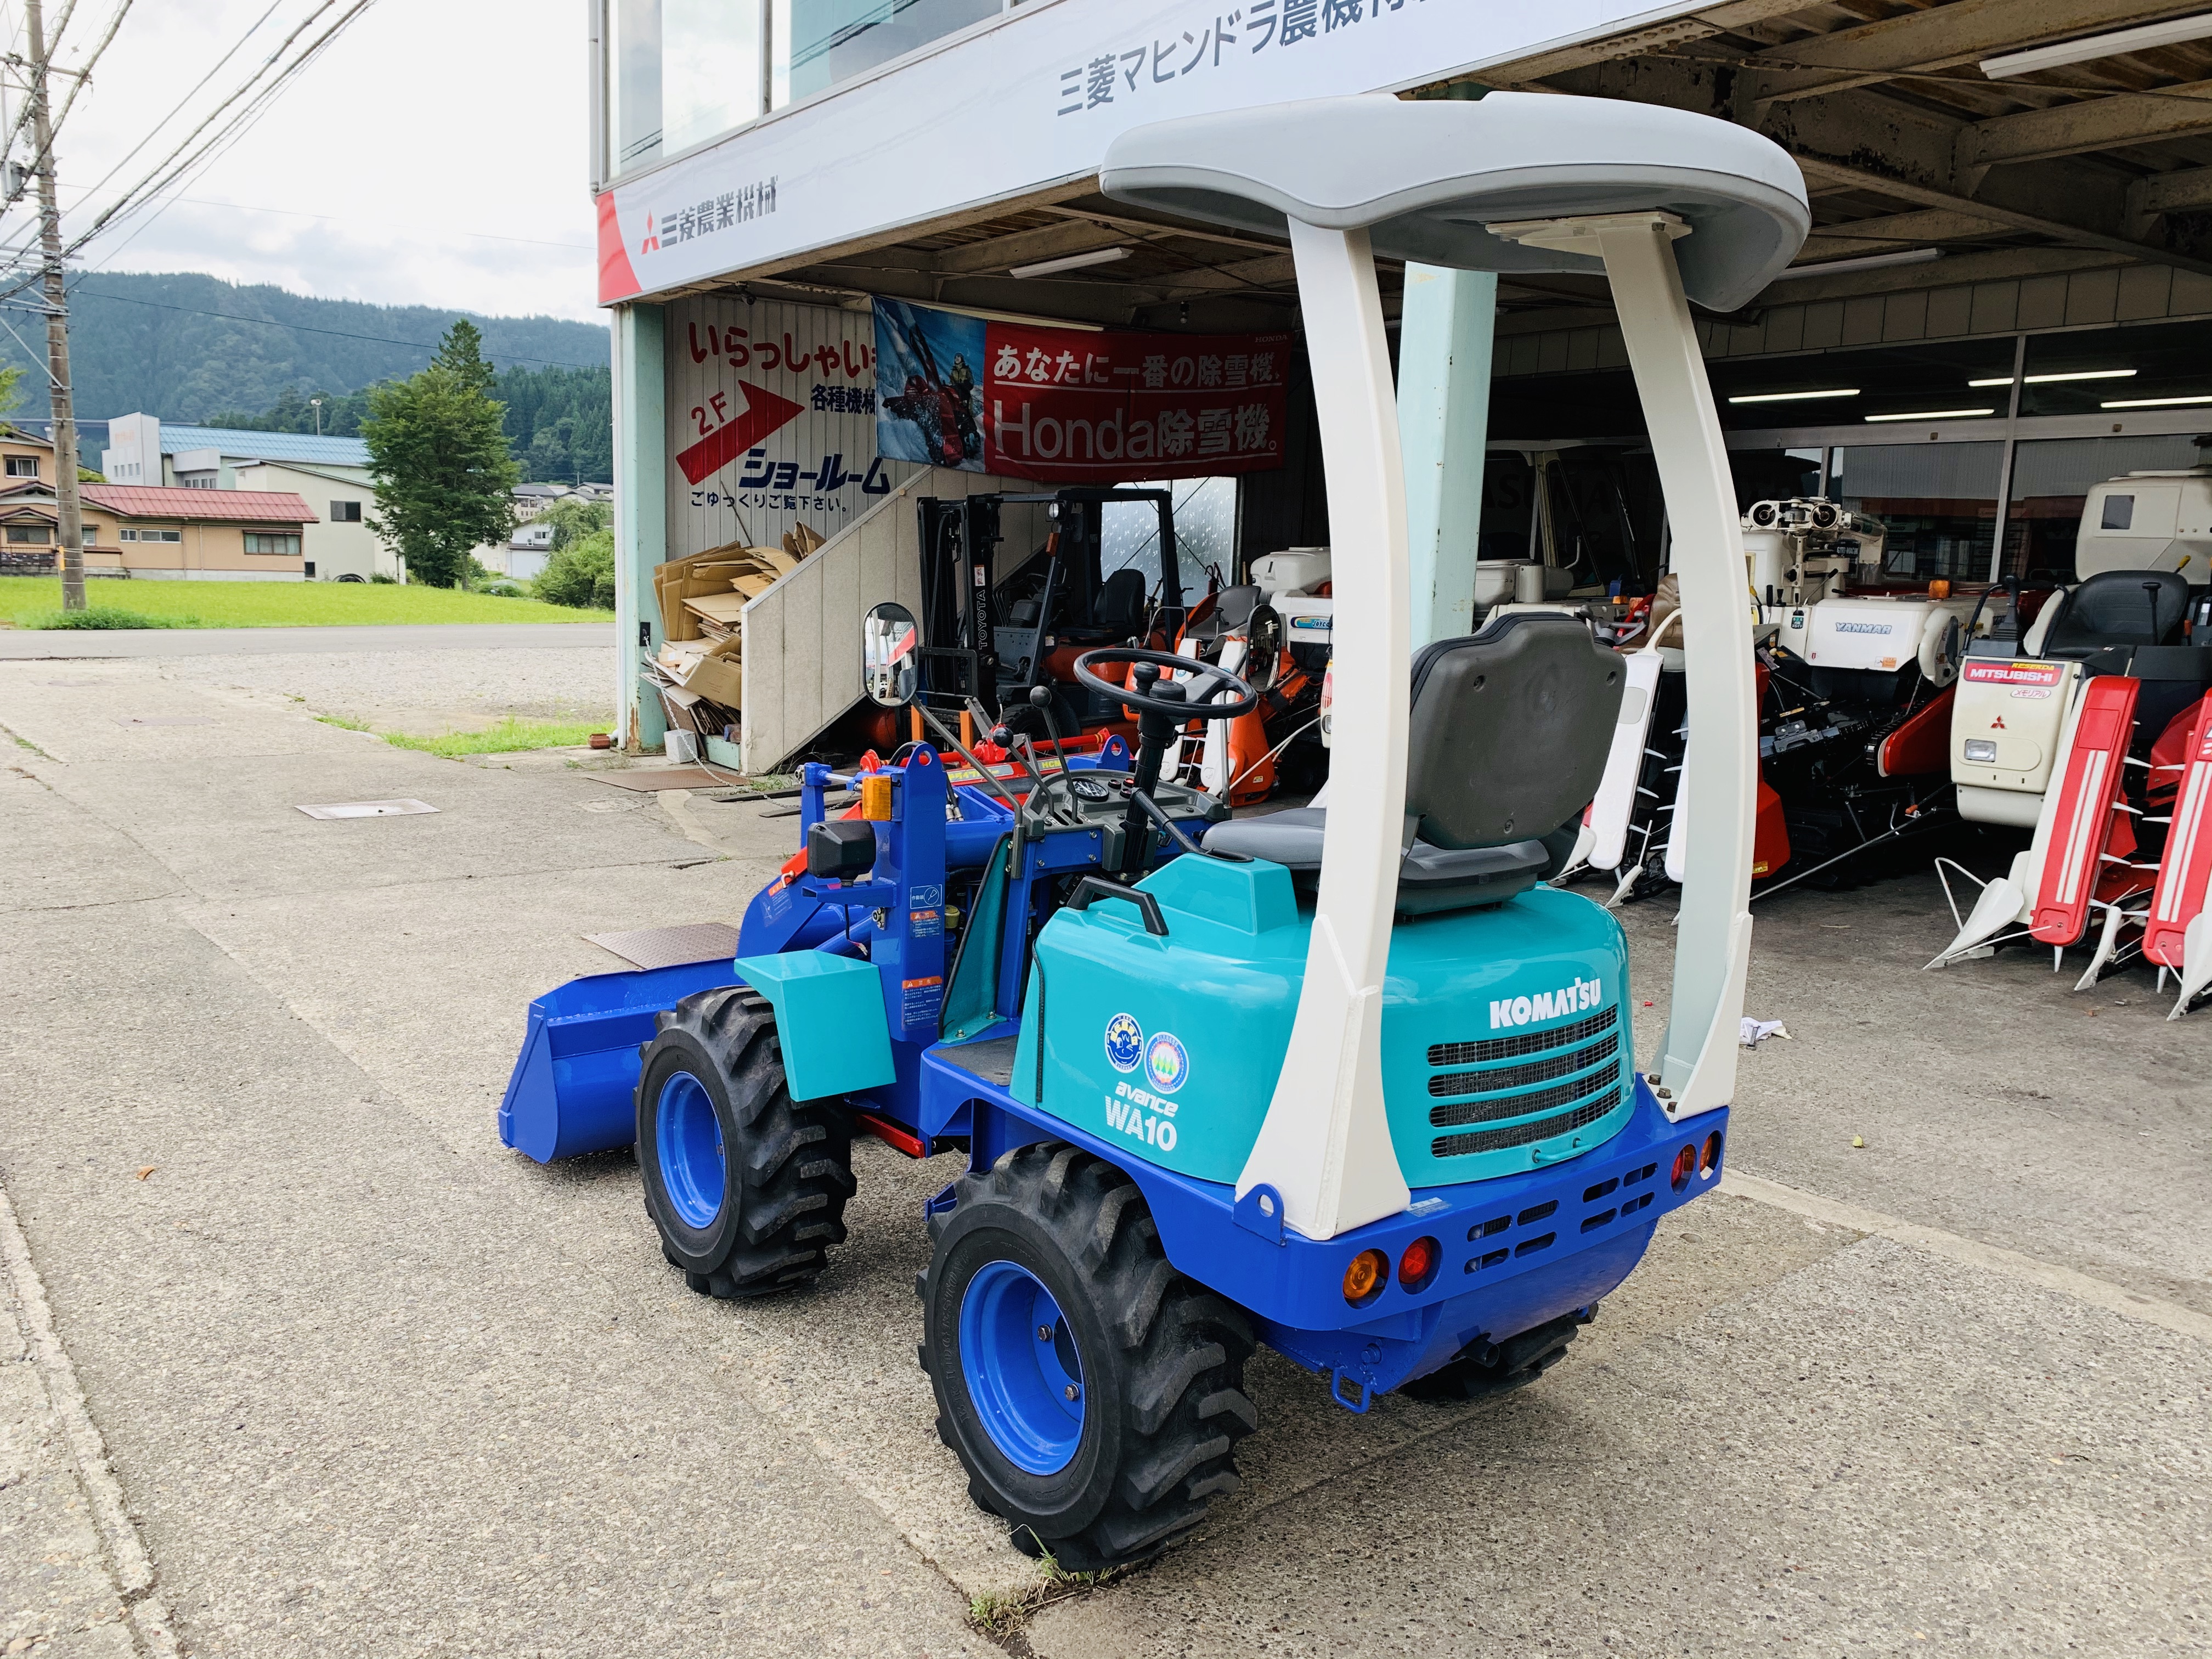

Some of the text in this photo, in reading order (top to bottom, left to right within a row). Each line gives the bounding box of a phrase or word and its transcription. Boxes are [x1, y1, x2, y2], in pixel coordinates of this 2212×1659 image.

[662, 174, 778, 248] 三菱農業機械
[689, 321, 876, 378] いらっしゃい
[1255, 334, 1289, 343] HONDA
[692, 391, 726, 436] 2F
[738, 448, 891, 494] ショールーム
[977, 589, 988, 650] TOYOTA
[1836, 622, 1892, 635] YANMAR
[1970, 668, 2053, 682] MITSUBISHI
[2014, 689, 2047, 698] メモリアル
[1489, 977, 1601, 1029] KOMATSU
[1115, 1080, 1179, 1118] avance
[1104, 1095, 1177, 1152] WA10
